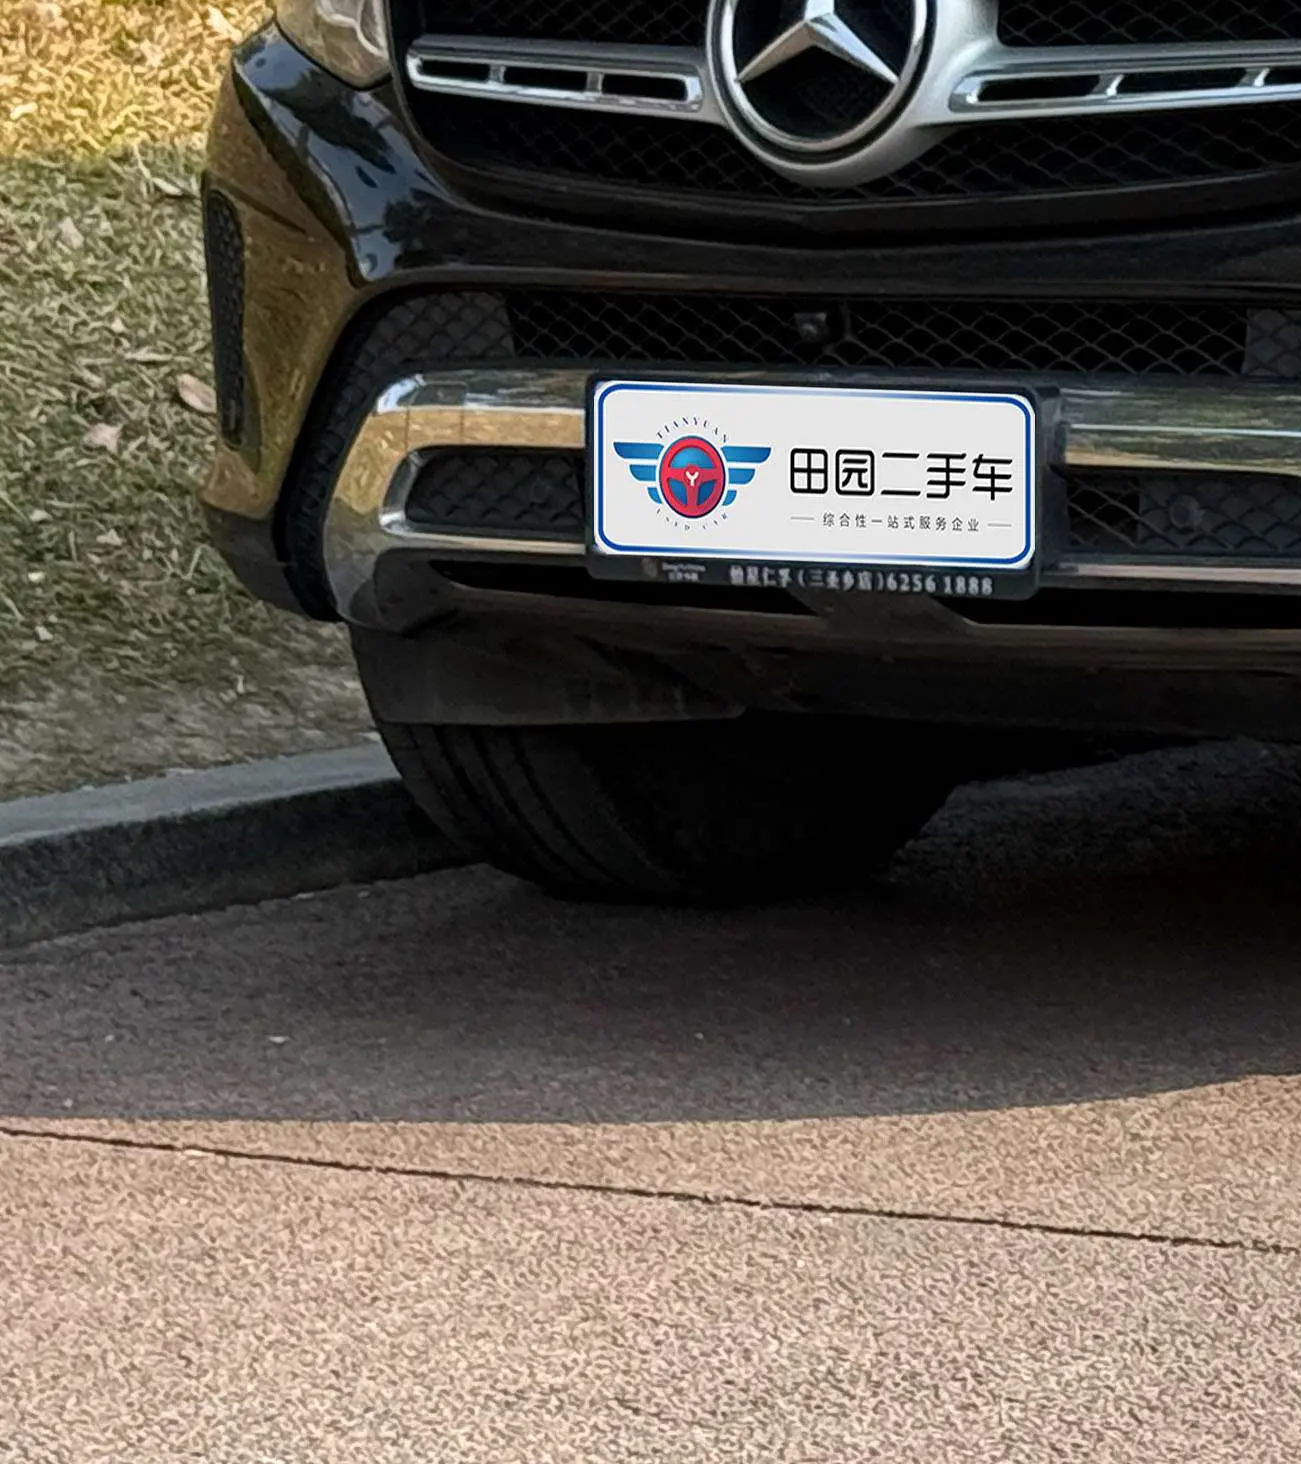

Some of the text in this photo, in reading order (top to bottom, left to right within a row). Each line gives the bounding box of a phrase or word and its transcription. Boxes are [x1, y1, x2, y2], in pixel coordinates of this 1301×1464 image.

[790, 447, 1013, 501] 田园二手车
[822, 512, 981, 532] 综合性一站式服务企业
